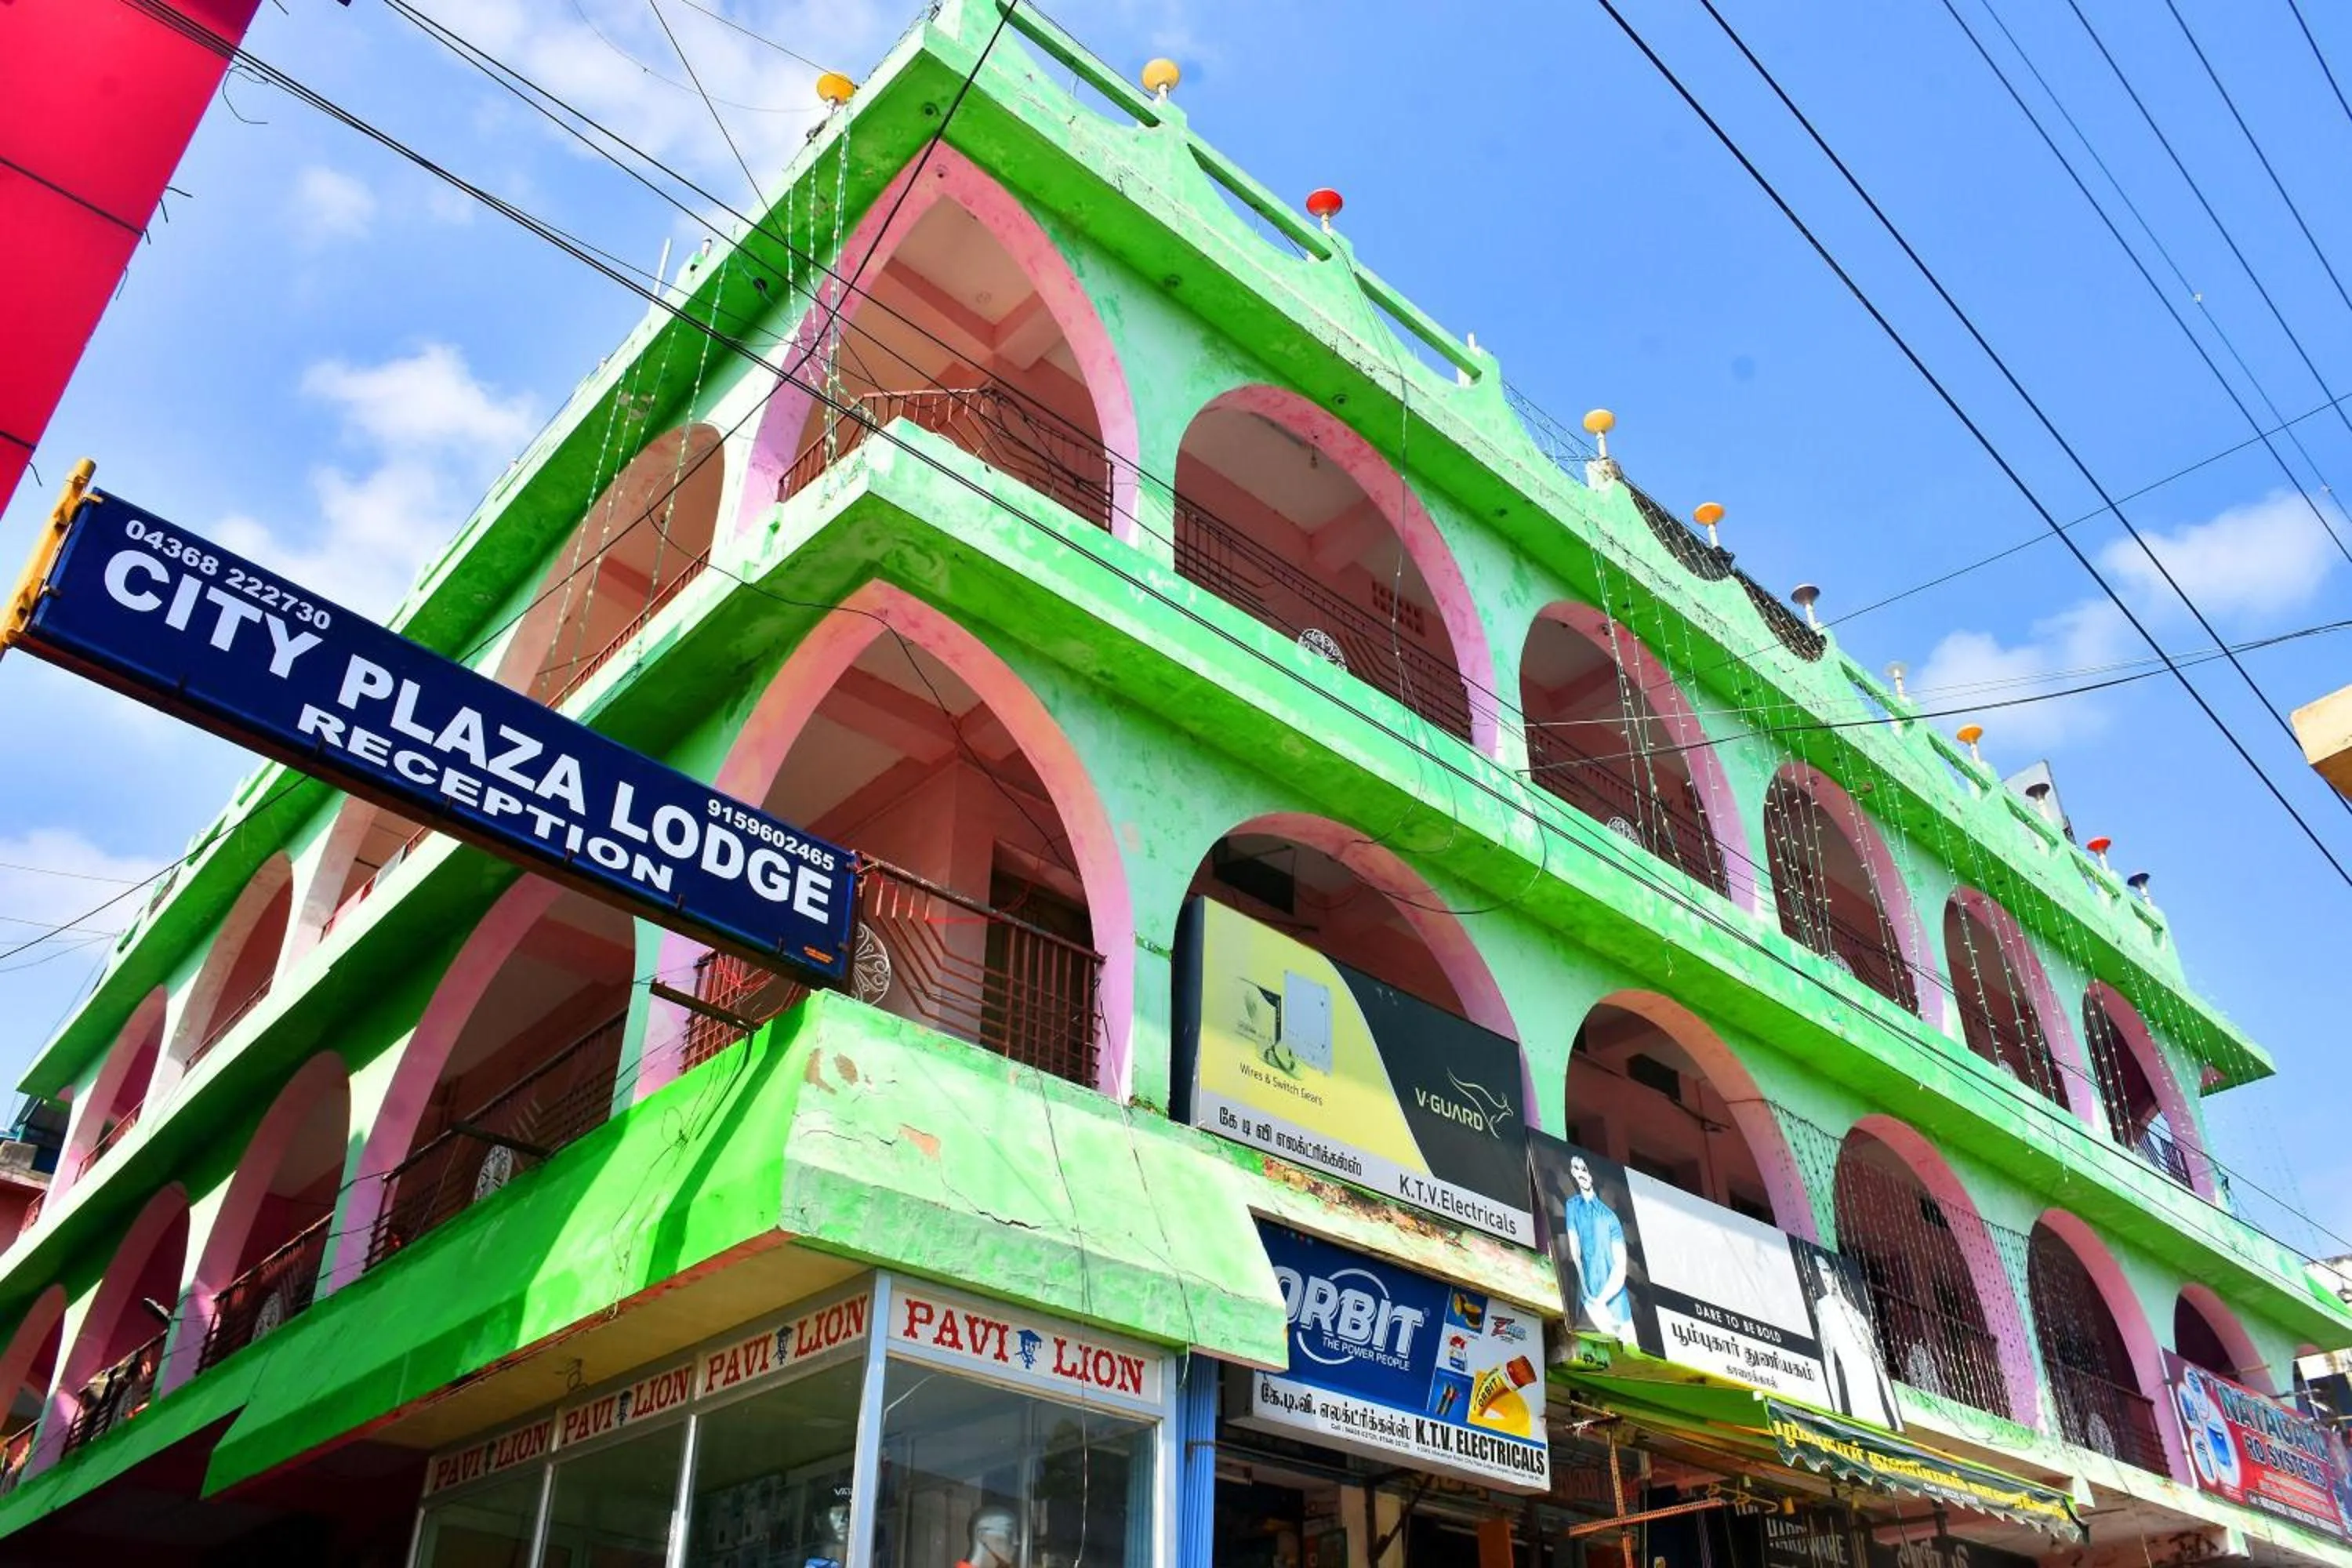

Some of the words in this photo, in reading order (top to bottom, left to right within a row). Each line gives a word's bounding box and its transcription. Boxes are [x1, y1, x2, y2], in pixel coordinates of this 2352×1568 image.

[125, 519, 220, 576] 04368
[225, 568, 332, 630] 222730
[104, 550, 323, 679] CITY
[337, 653, 586, 815] PLAZA
[610, 780, 833, 924] LODGE
[297, 703, 673, 892] RECEPTION
[707, 798, 834, 872] 9159602465
[1240, 1062, 1263, 1081] Wires
[1272, 1076, 1299, 1095] Switch
[1301, 1087, 1323, 1106] Gears
[1399, 1174, 1517, 1235] K.T.V.Electricals
[706, 1335, 770, 1391] PAVI
[793, 1294, 867, 1357] LION
[903, 1298, 1009, 1363] PAVI
[1052, 1337, 1145, 1396] LION
[1273, 1265, 1425, 1359] ORBIT
[1694, 1303, 1722, 1323] DARE
[1726, 1314, 1740, 1329] TO
[1323, 1336, 1340, 1350] THE
[1341, 1343, 1374, 1360] POWER
[1376, 1352, 1410, 1371] PEOPLE
[561, 1396, 615, 1446] PAVI
[631, 1366, 694, 1417] LION
[434, 1450, 481, 1490] PAVI
[494, 1421, 551, 1468] LION
[1415, 1418, 1453, 1450] K.T.V.
[1456, 1428, 1545, 1475] ELECTRICALS
